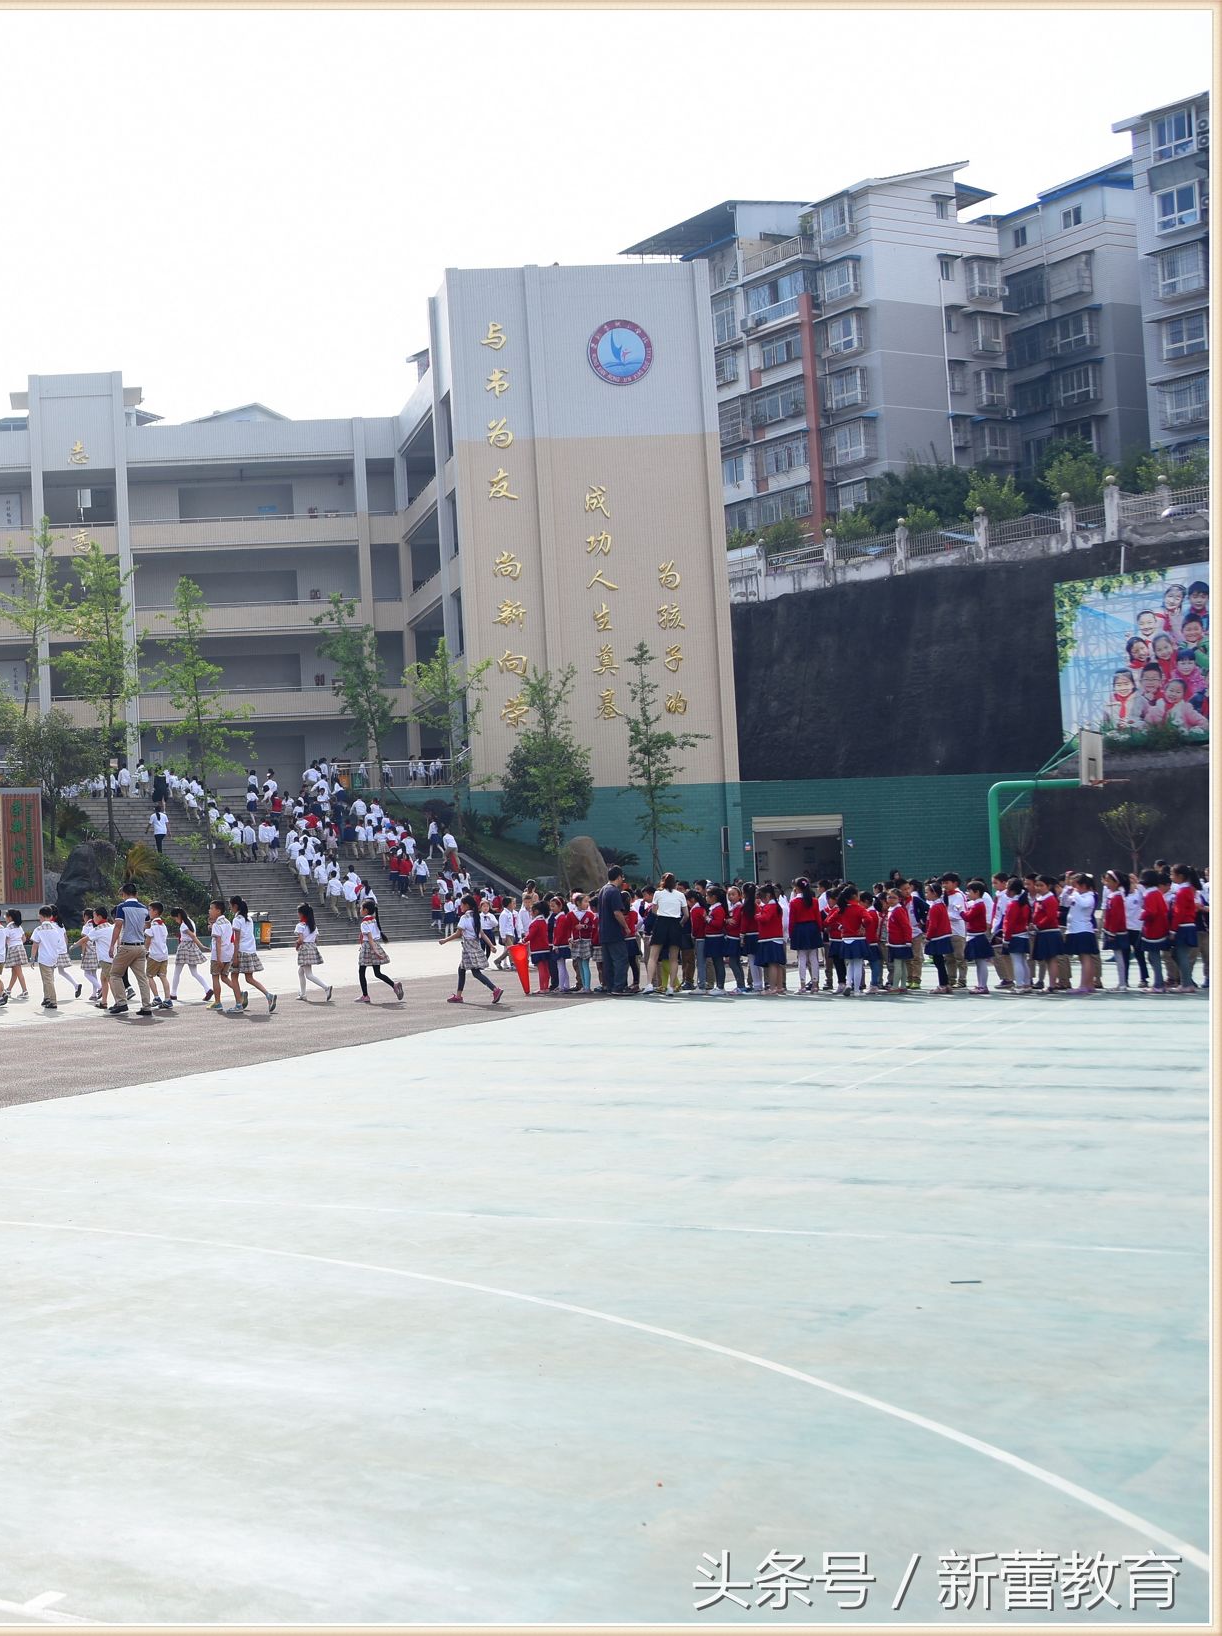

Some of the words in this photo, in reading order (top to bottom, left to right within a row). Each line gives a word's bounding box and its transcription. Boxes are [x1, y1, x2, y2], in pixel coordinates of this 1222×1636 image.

[480, 322, 518, 501] 与书为友
[492, 551, 529, 728] 尚新向荣
[584, 486, 624, 720] 成功人生奠基
[657, 560, 688, 715] 为孩子的
